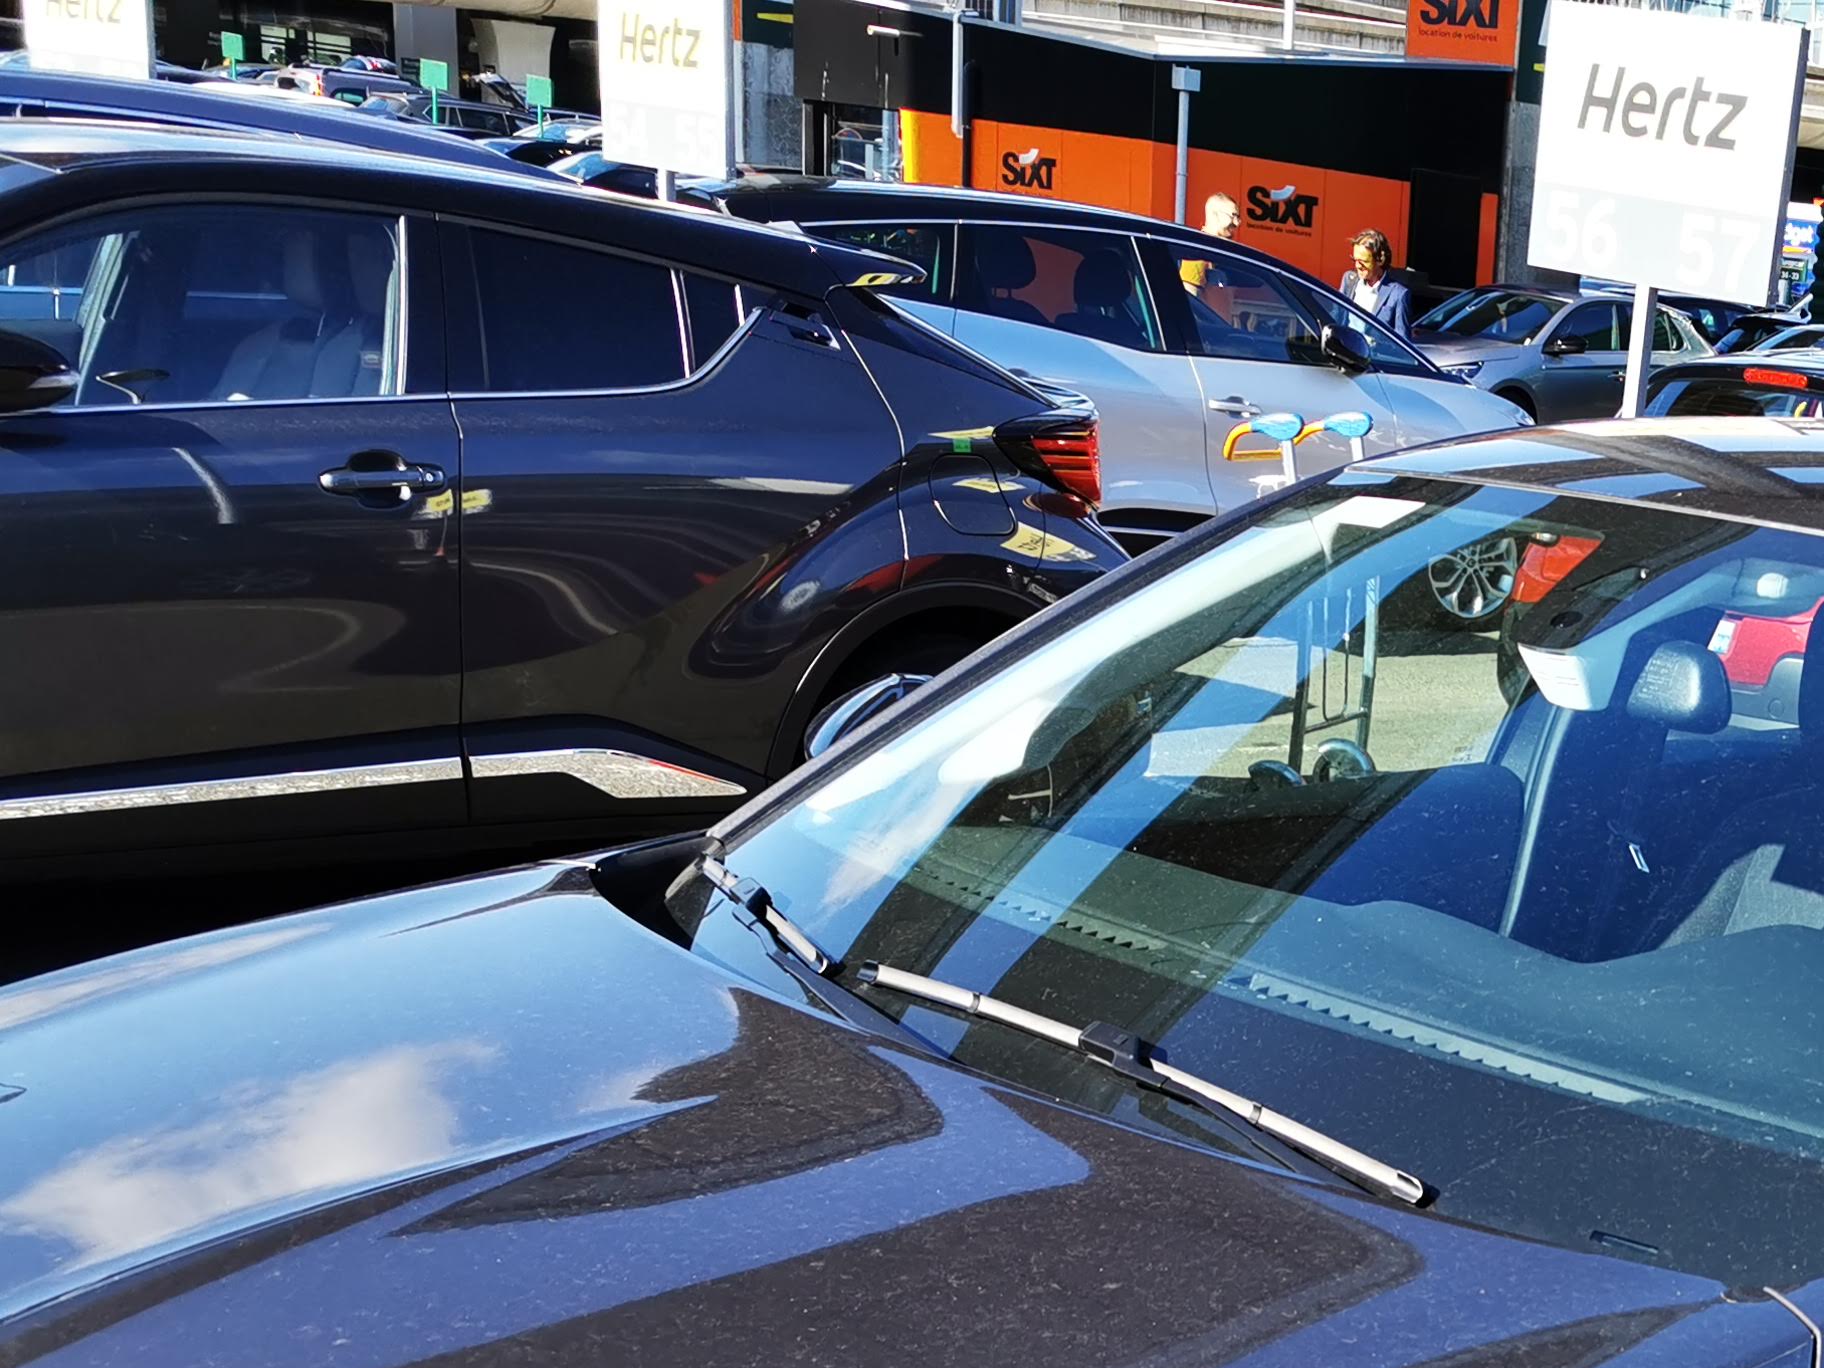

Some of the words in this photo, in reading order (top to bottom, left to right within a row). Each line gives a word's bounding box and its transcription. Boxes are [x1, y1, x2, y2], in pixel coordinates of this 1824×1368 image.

[620, 12, 701, 68] Hertz
[1418, 28, 1451, 38] location
[1464, 32, 1497, 42] voitures
[1577, 63, 1748, 150] Hertz
[1546, 190, 1617, 271] 56
[1677, 211, 1761, 294] 57
